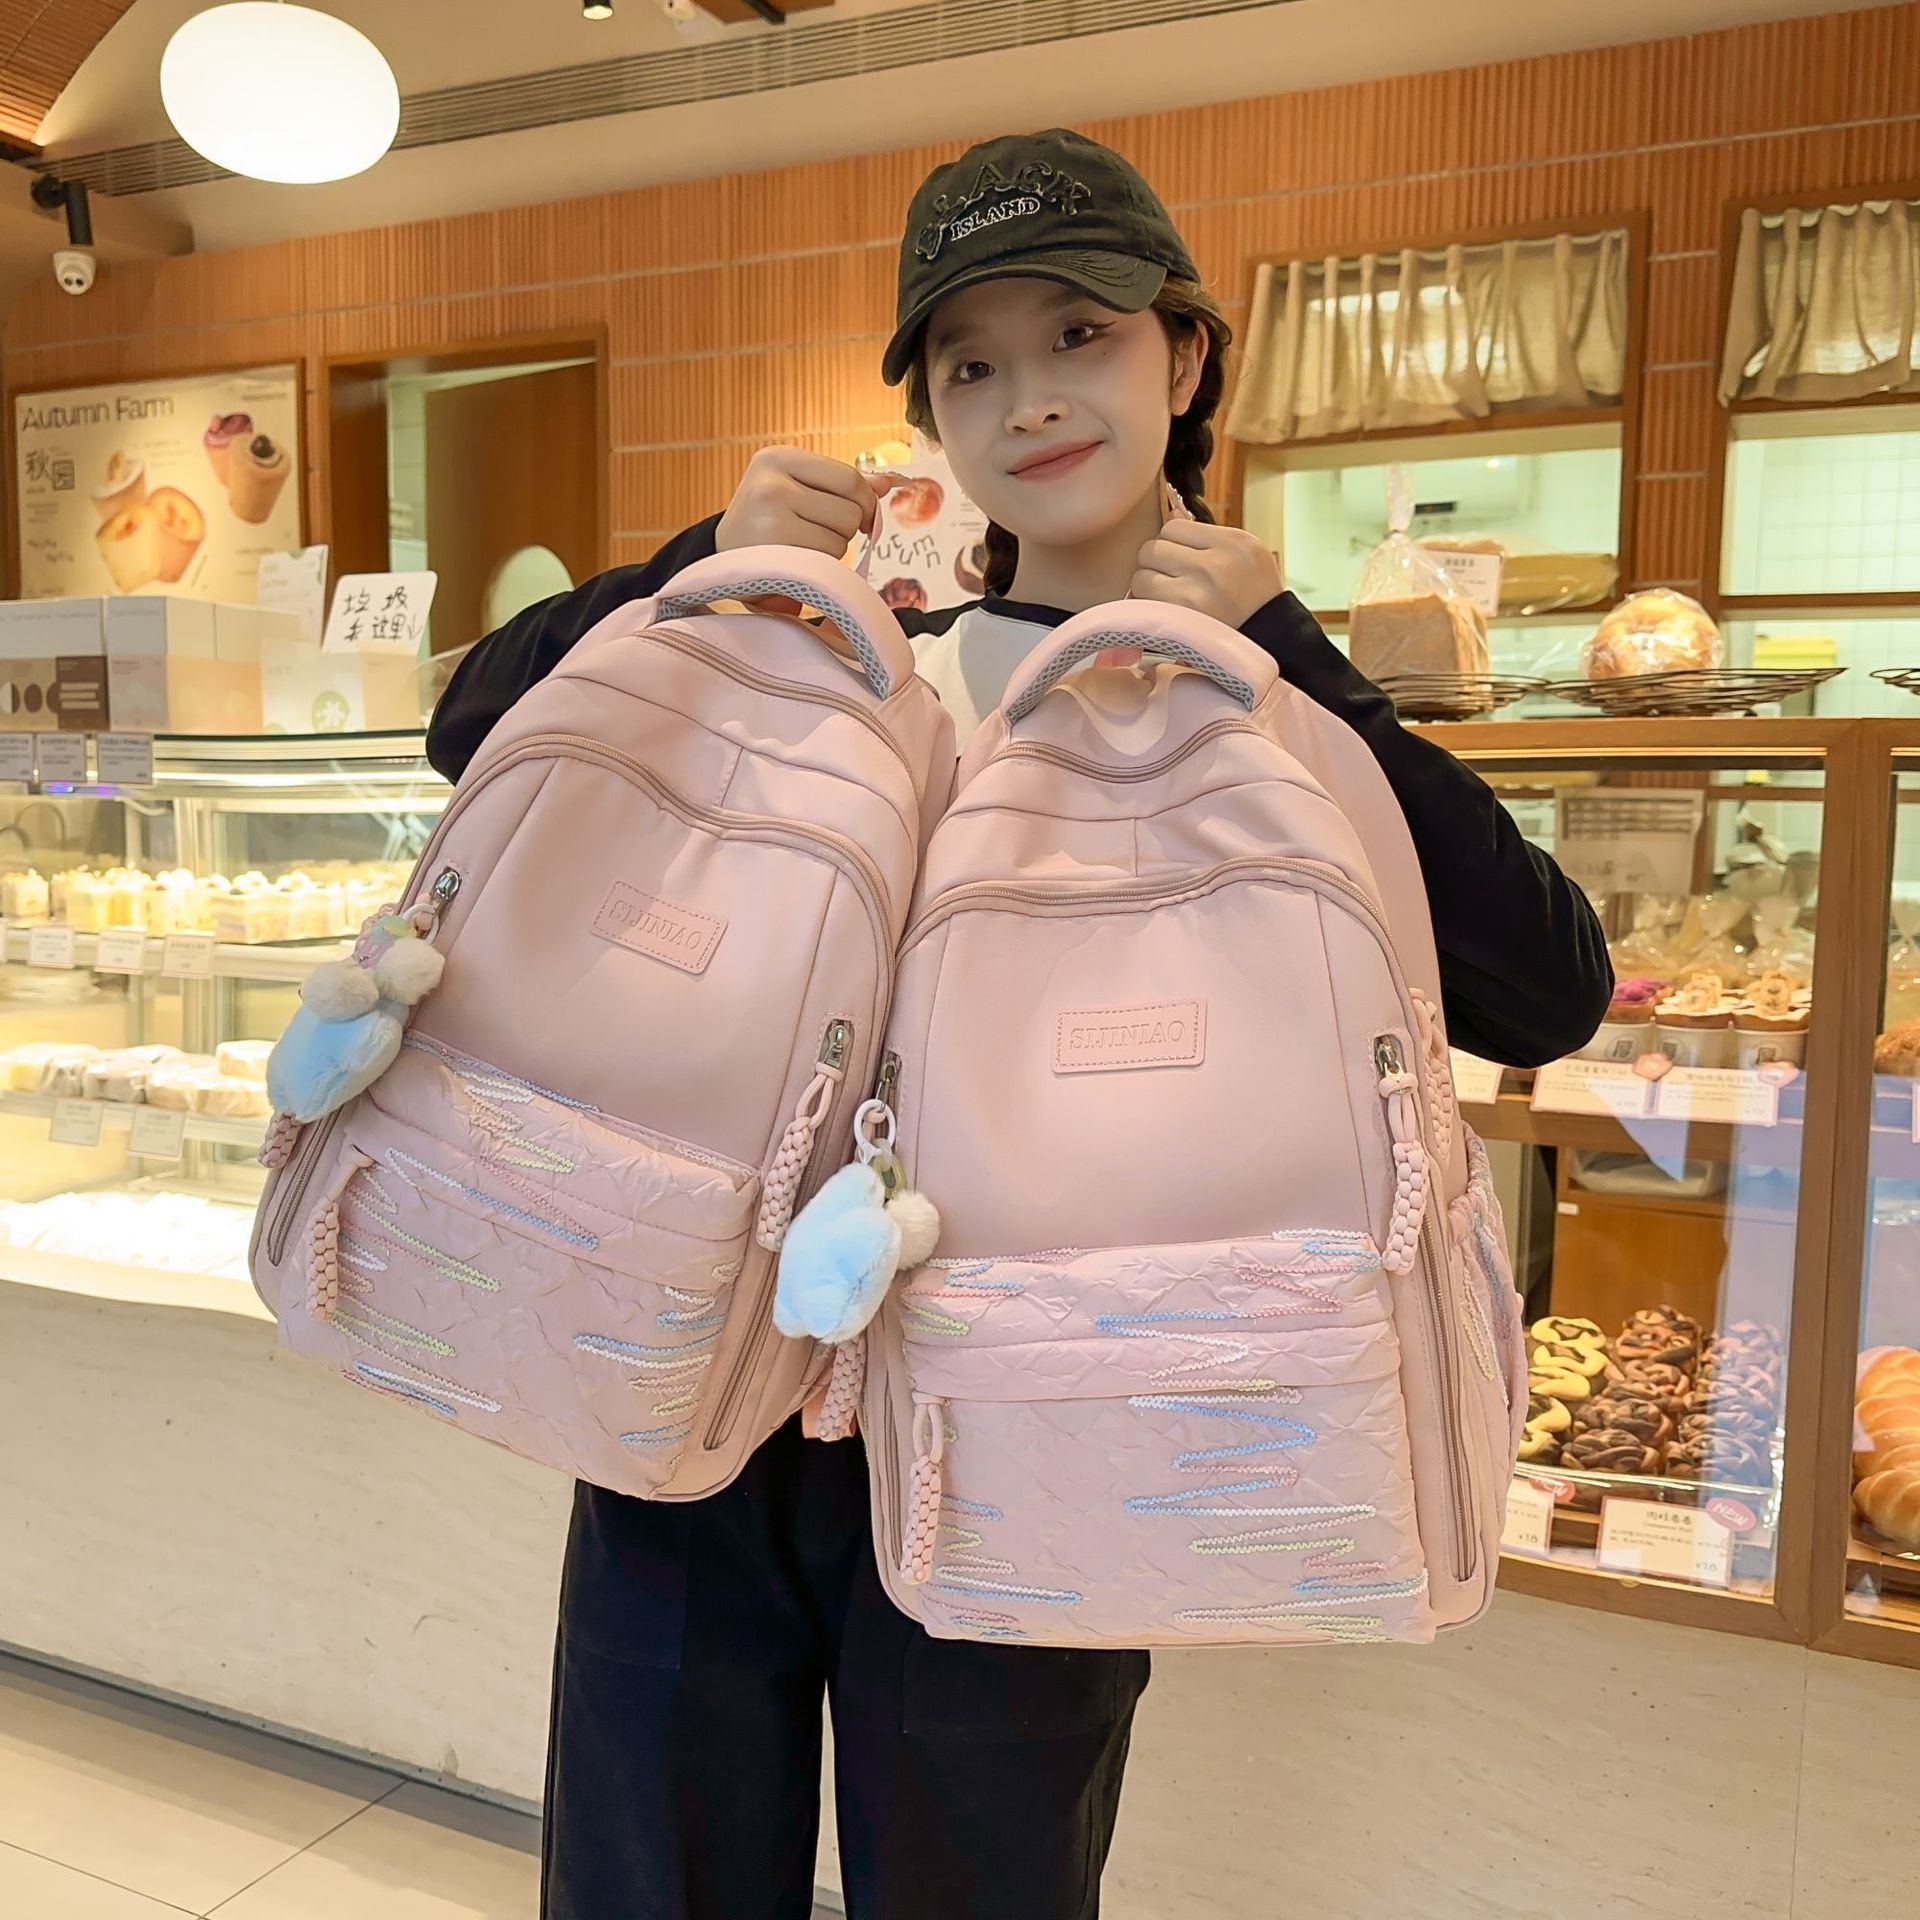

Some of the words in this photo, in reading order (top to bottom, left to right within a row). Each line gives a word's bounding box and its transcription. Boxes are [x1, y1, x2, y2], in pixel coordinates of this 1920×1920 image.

[950, 197, 1041, 241] ISLAND
[22, 404, 110, 432] Autumn
[117, 396, 175, 421] Farm
[1069, 1009, 1187, 1050] SIJINIAO
[1713, 1502, 1749, 1526] NEW
